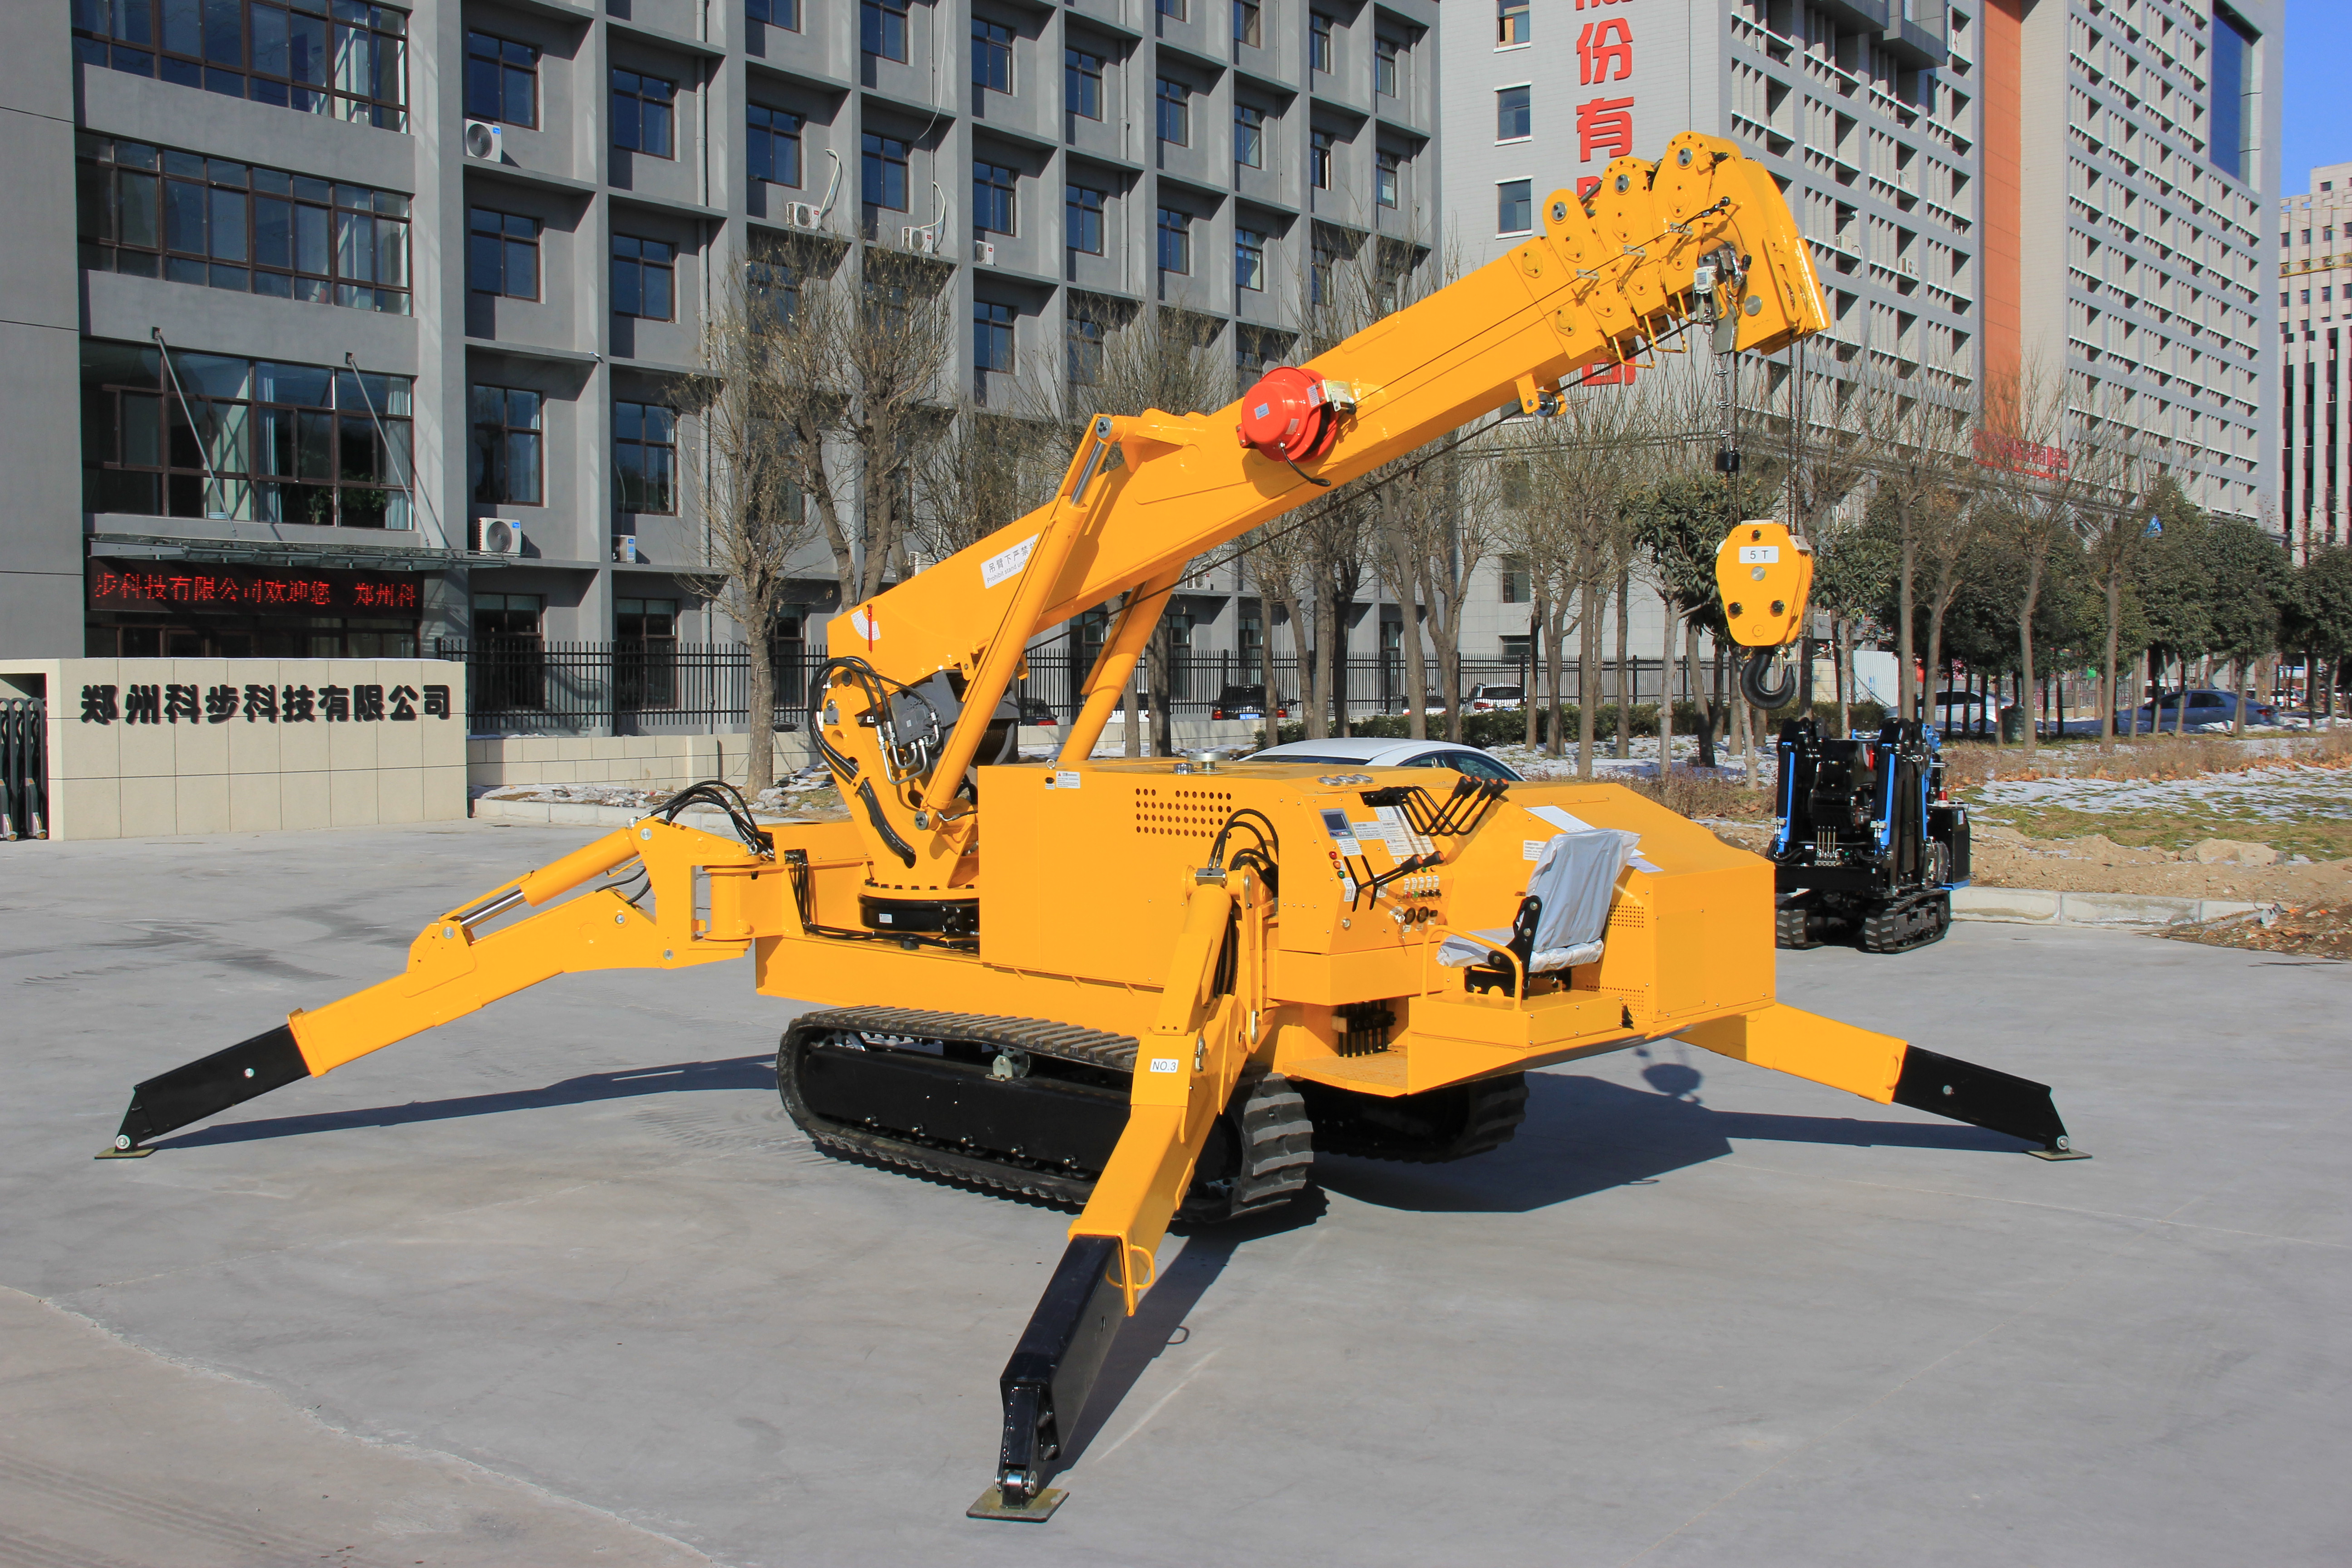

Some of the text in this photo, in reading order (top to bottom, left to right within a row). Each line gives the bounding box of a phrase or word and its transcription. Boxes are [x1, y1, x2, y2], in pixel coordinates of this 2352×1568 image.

[987, 571, 1004, 583] Prohibit
[1004, 564, 1017, 575] stand
[81, 684, 451, 725] 郑州科步科技有限公司
[1152, 1061, 1176, 1071] NO.3
